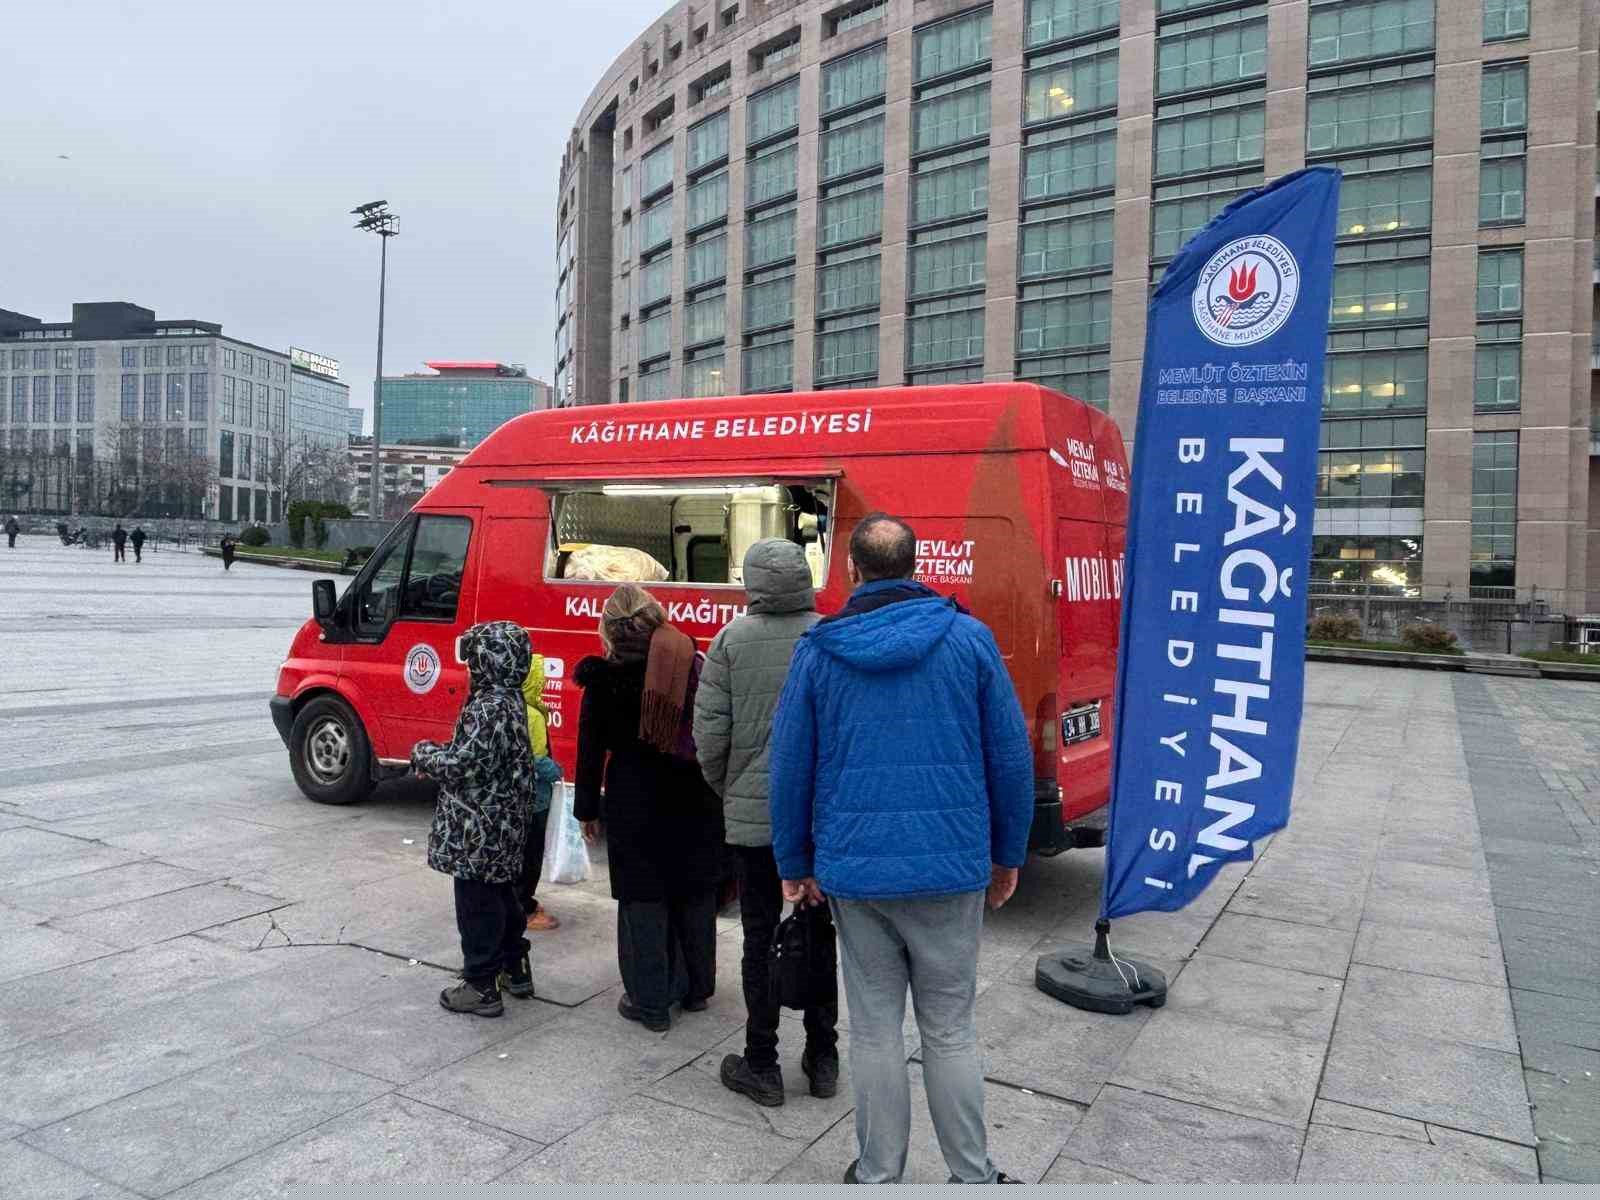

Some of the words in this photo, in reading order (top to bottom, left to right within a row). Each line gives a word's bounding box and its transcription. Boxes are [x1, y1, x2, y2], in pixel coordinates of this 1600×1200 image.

[1159, 363, 1225, 384] MEVLÜT
[1227, 358, 1307, 383] ÖZTEKİN
[1157, 385, 1227, 405] BELEDİYE
[1234, 386, 1306, 407] BAŞKANI
[570, 420, 705, 444] KÂĞITHANE
[713, 407, 873, 438] BELEDİYESİ
[1065, 550, 1112, 602] MOBİL
[565, 596, 604, 618] KAL
[667, 599, 748, 625] KAĞITH
[1144, 437, 1206, 890] BELEDİYESİ
[1187, 437, 1297, 879] KÂĞITHAN
